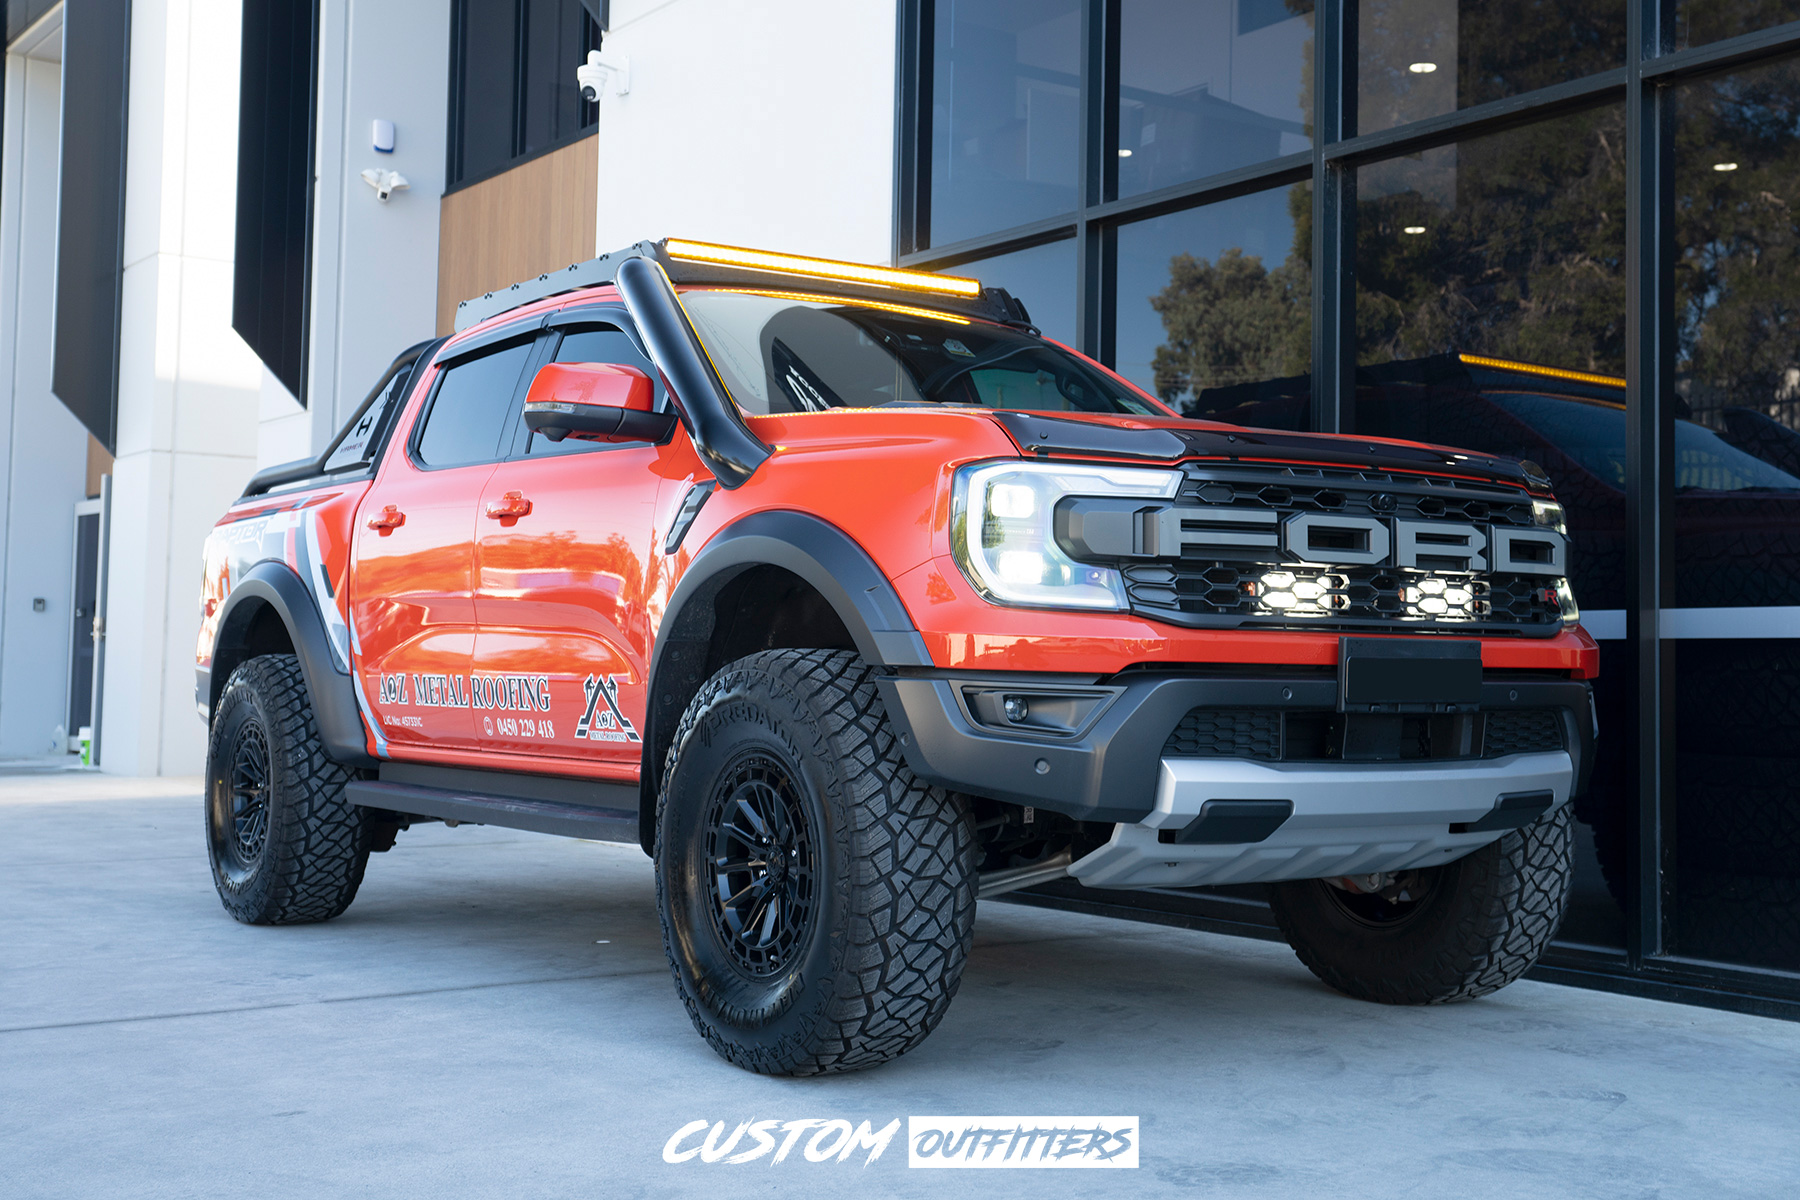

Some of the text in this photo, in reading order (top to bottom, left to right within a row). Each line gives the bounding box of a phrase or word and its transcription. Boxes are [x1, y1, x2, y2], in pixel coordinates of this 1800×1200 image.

[1158, 504, 1567, 577] FORD
[412, 673, 469, 708] METAL
[470, 675, 551, 712] ROOFING
[497, 718, 555, 739] 0450 229 418
